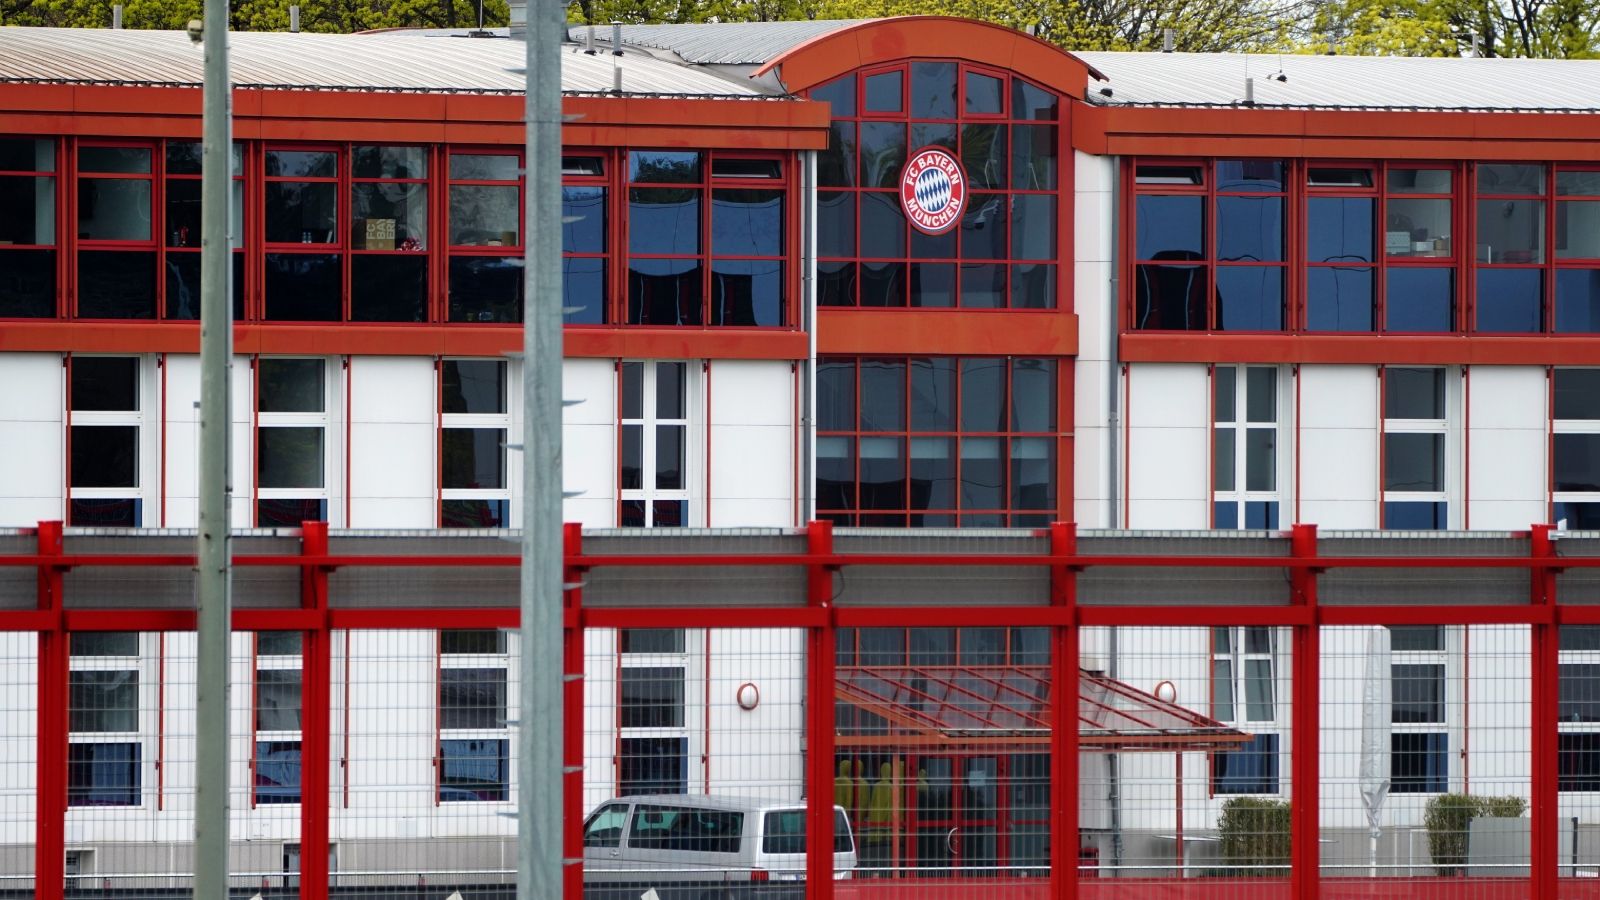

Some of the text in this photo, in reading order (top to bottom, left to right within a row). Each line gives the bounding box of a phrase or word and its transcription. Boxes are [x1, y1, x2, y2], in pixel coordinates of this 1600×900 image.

[907, 154, 959, 185] FC BAYERN
[907, 198, 959, 226] MÜNCHEN
[366, 223, 375, 239] FC
